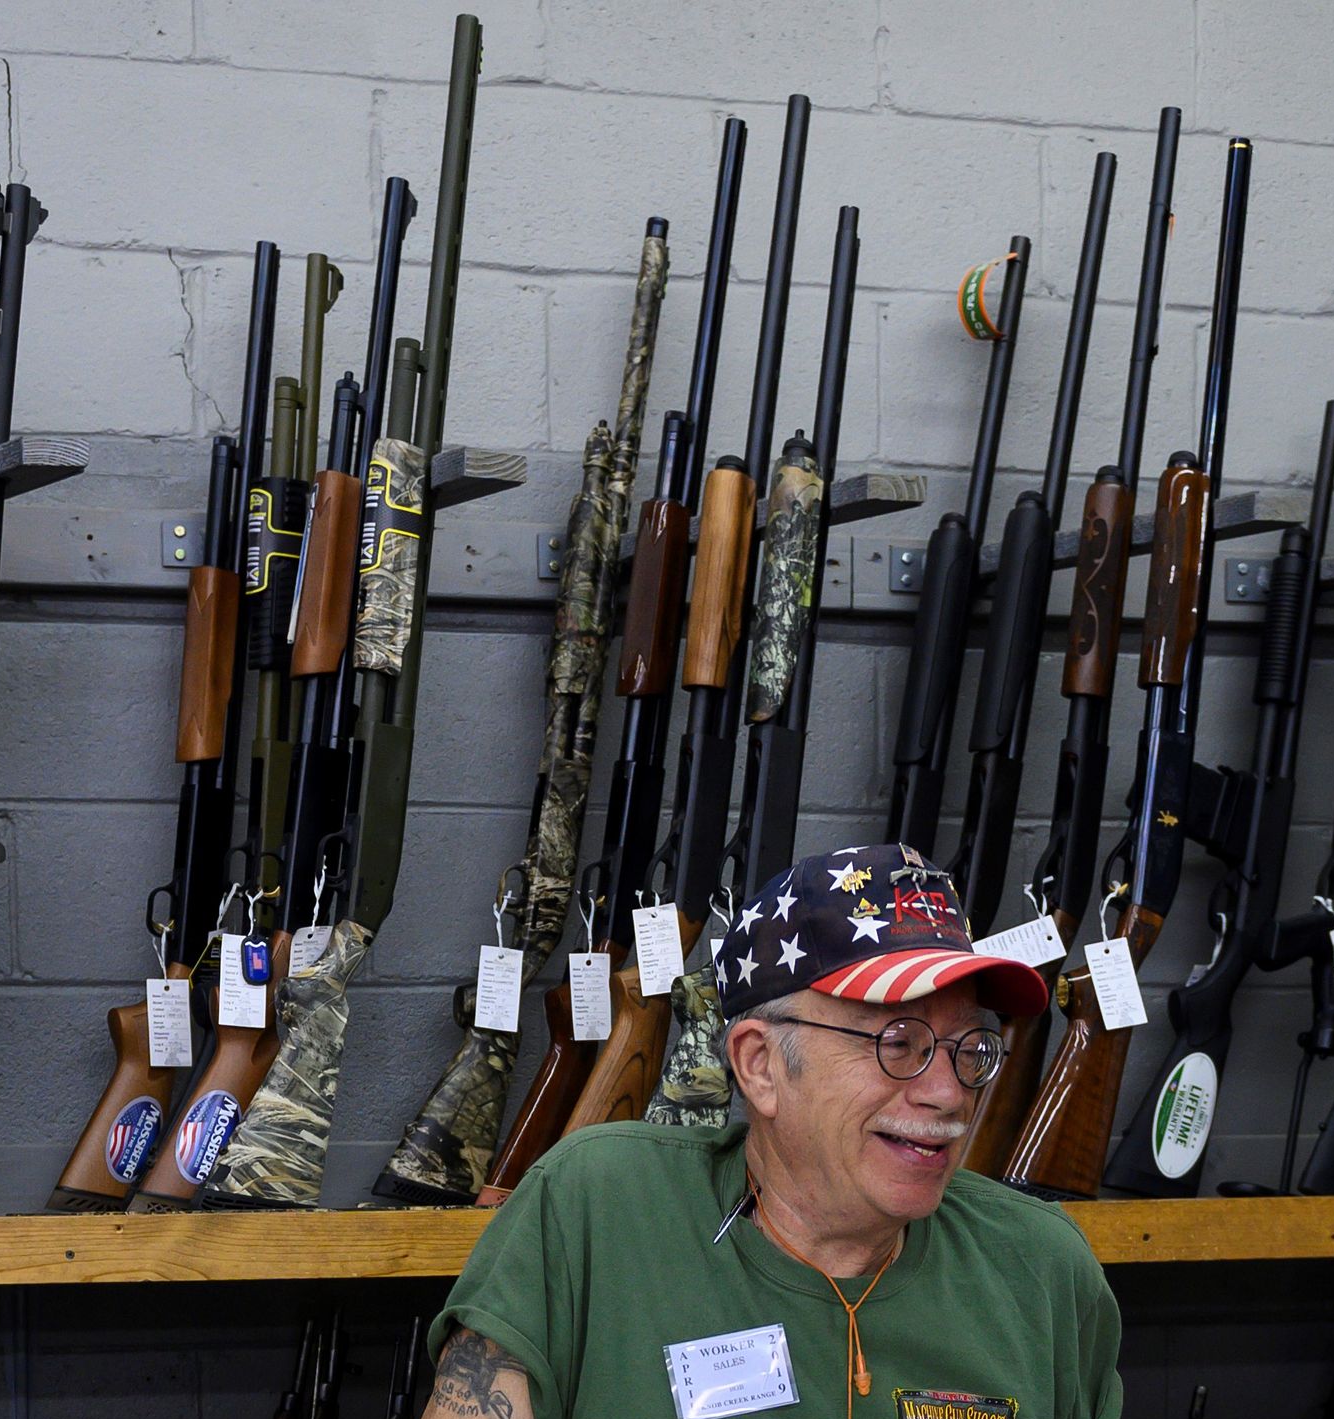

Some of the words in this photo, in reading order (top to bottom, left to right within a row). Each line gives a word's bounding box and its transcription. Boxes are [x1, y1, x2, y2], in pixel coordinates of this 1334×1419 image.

[1168, 1090, 1187, 1134] WARRANTY
[1175, 1085, 1202, 1148] LIFETIME
[123, 1104, 161, 1180] MOSSBERG
[196, 1096, 238, 1181] MOSSBERG
[699, 1338, 755, 1358] WORKER
[713, 1356, 746, 1371] SALES
[723, 1396, 749, 1408] CREEK
[750, 1390, 776, 1402] RANGE
